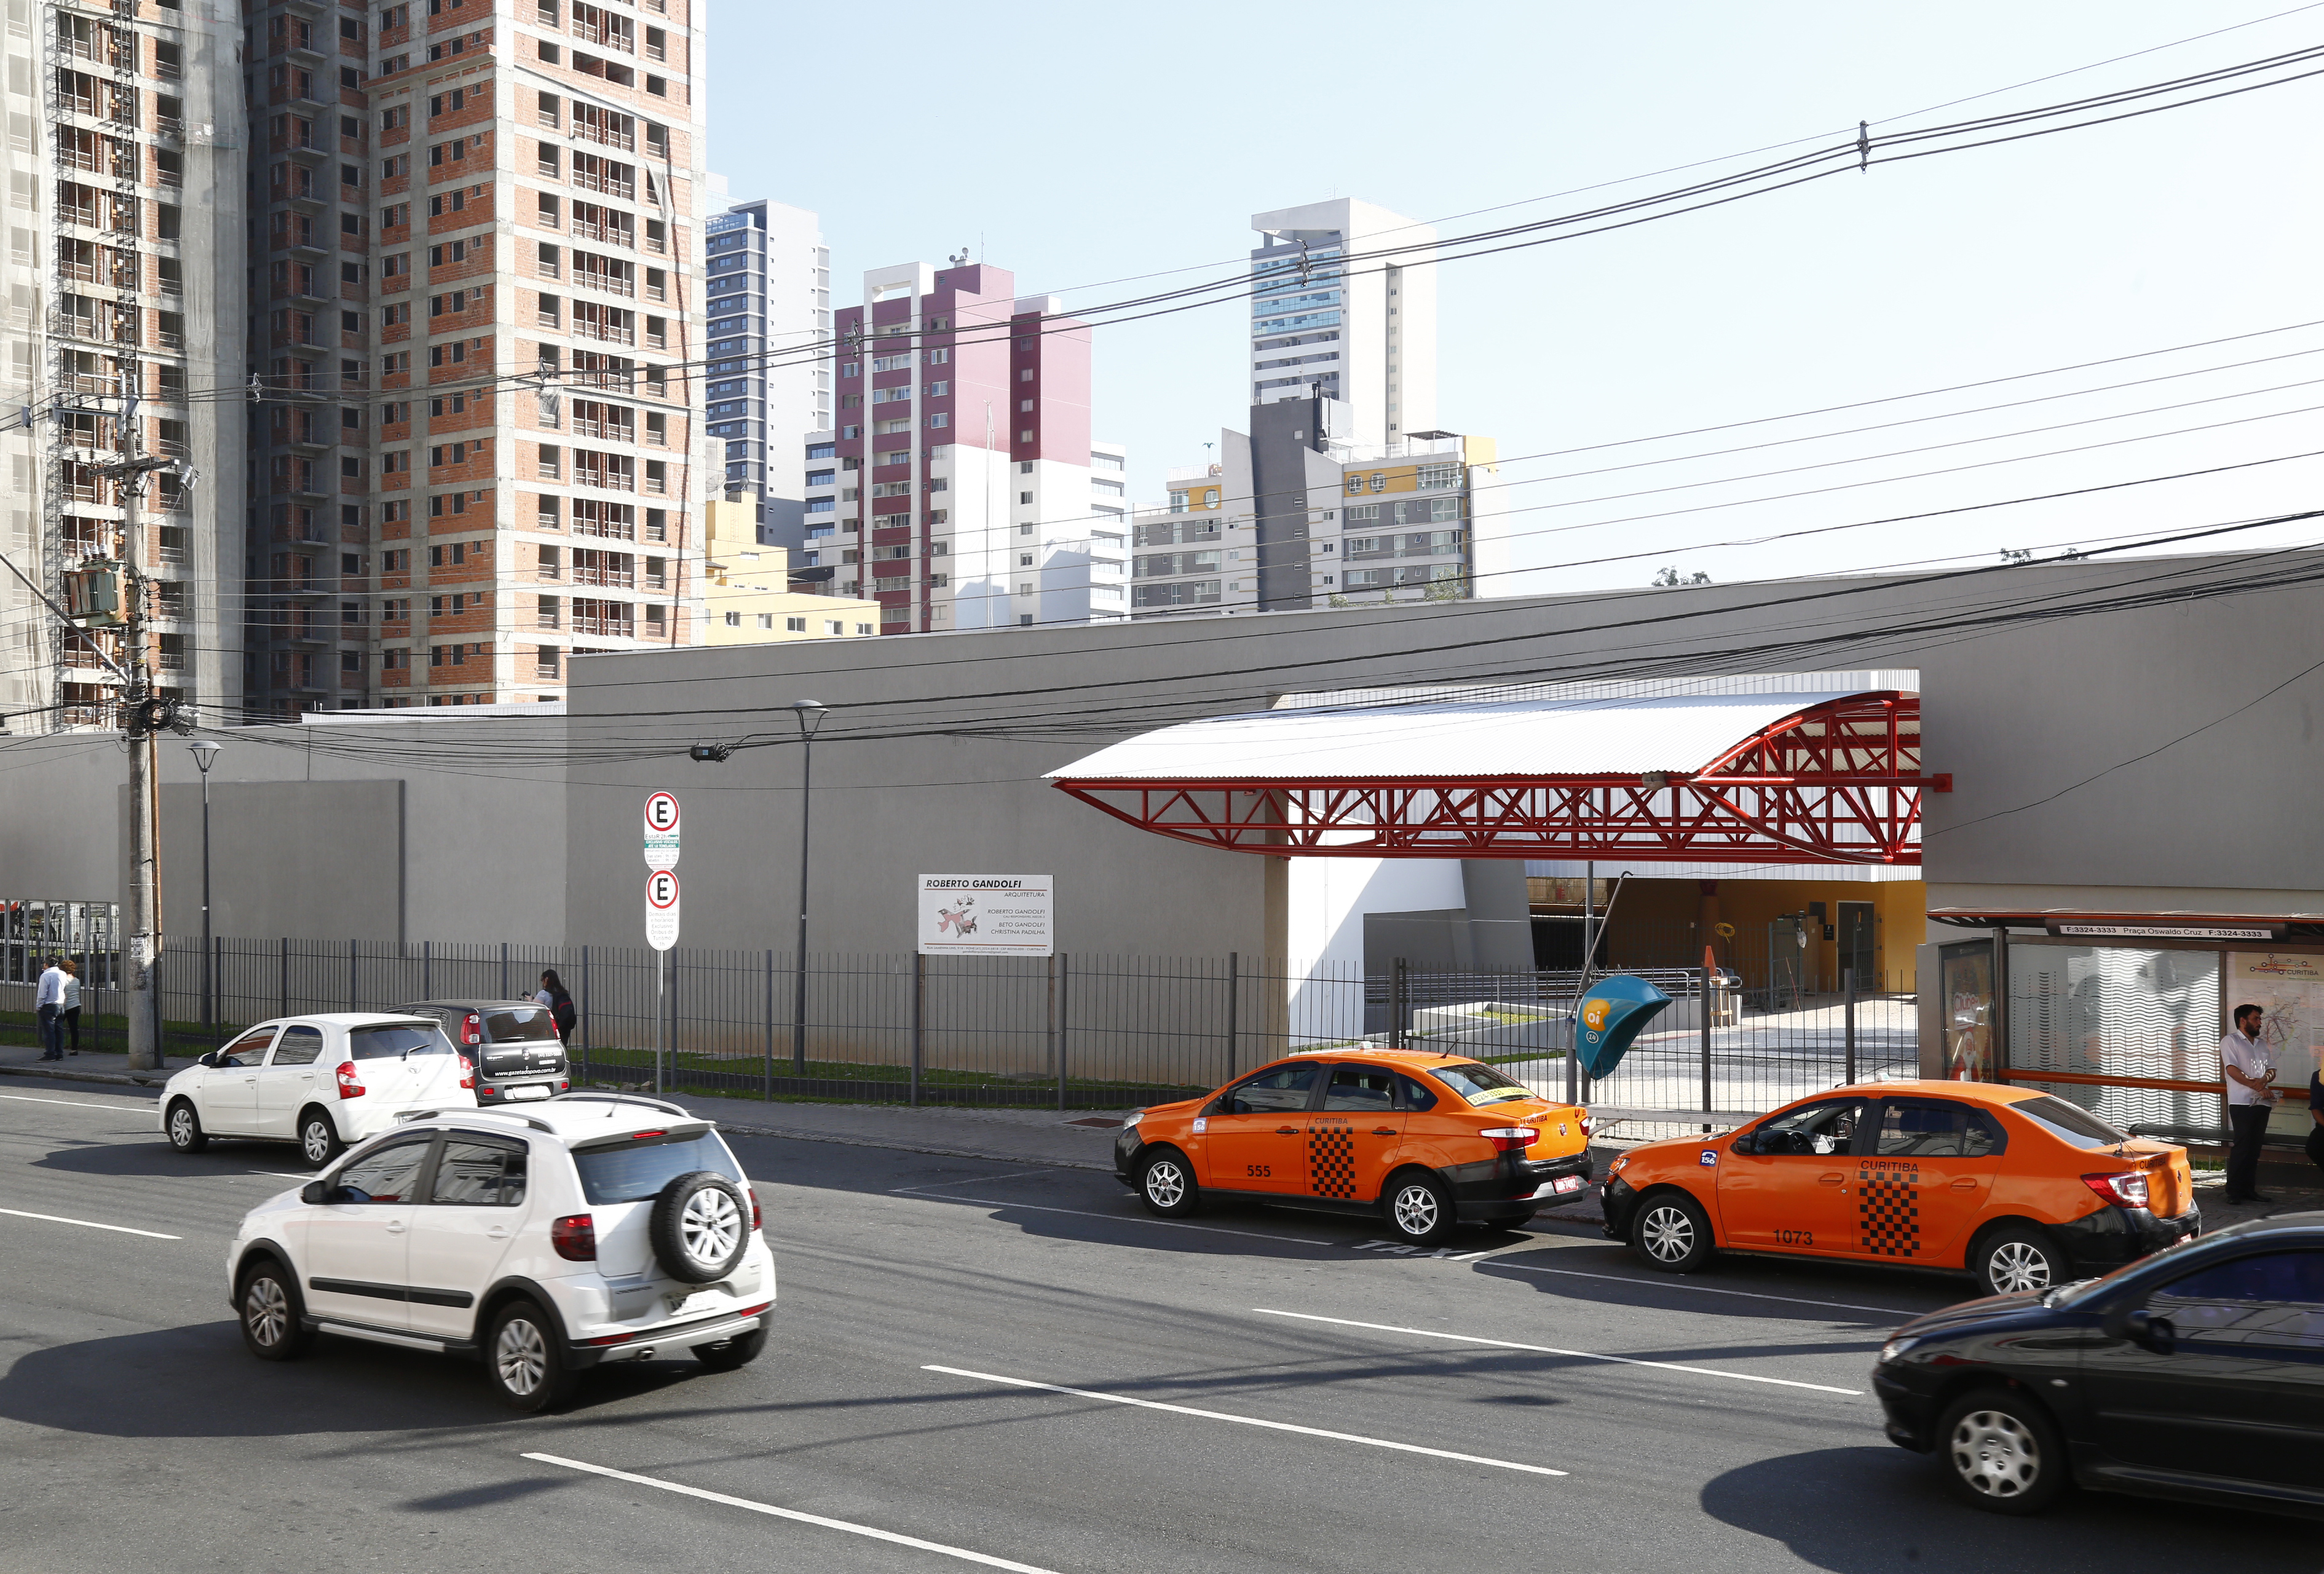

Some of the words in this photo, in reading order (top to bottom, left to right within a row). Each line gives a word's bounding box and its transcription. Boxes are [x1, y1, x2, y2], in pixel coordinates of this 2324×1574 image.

[657, 801, 668, 823] E
[657, 878, 668, 900] E
[494, 1067, 556, 1076] www.gazetadopovo.com.br
[1470, 1090, 1504, 1103] 3324-3333
[1524, 1115, 1547, 1125] CURITIBA
[1701, 1156, 1716, 1165] 156
[1860, 1160, 1919, 1173] CURITIBA
[2140, 1157, 2166, 1169] CURITIBA
[1247, 1165, 1271, 1177] 555
[1773, 1228, 1813, 1246] 1073
[1351, 1240, 1491, 1260] TAXI
